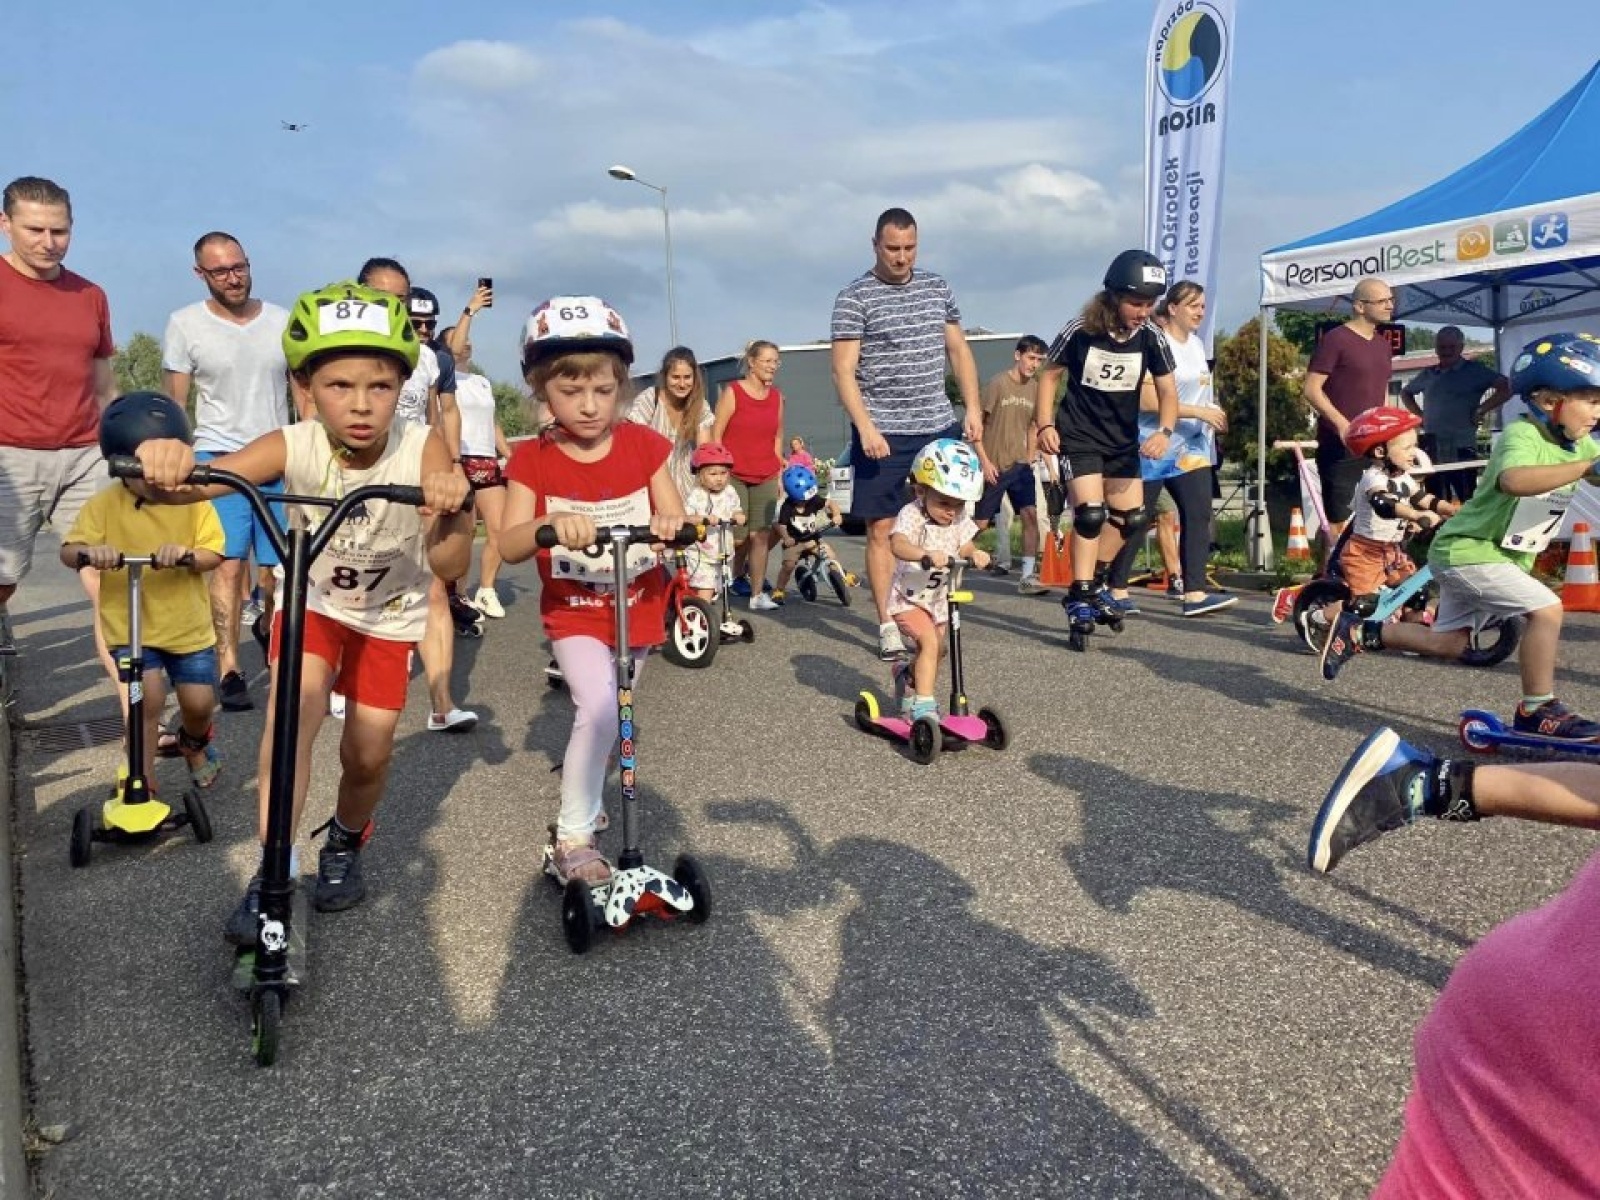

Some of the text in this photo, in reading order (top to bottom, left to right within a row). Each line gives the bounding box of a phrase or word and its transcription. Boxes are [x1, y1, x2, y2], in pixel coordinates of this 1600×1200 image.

[1285, 239, 1446, 287] PersonalBest
[1151, 267, 1163, 279] 52
[336, 301, 368, 320] 87
[559, 305, 589, 321] 63
[1099, 364, 1126, 381] 52
[331, 566, 391, 592] 87
[926, 570, 949, 590] 5
